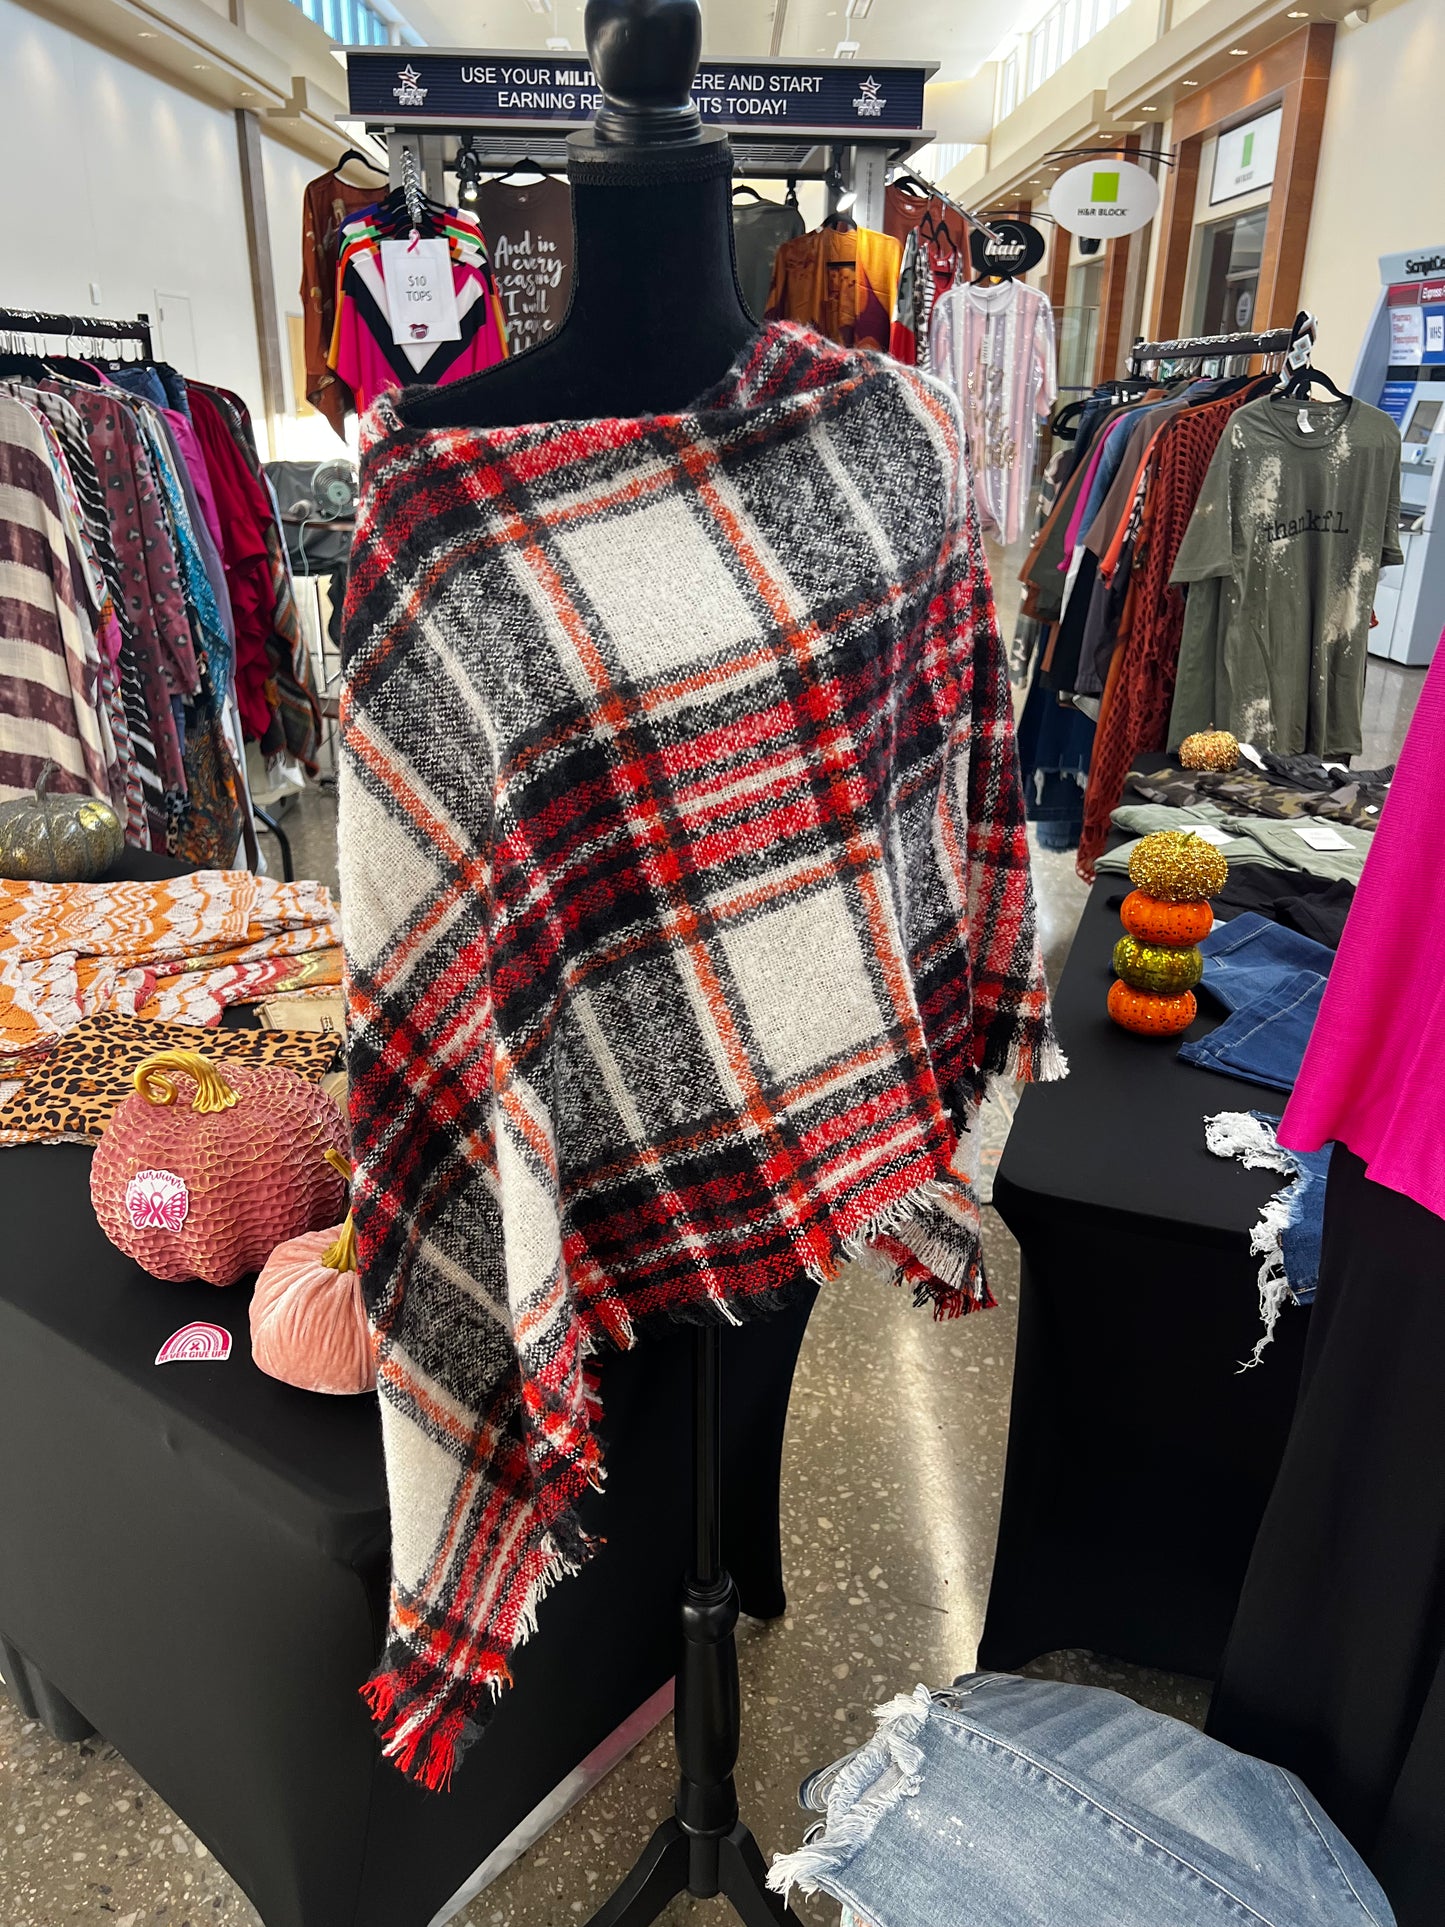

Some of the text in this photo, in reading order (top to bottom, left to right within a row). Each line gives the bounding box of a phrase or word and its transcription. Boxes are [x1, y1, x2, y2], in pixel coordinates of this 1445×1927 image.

[461, 67, 597, 87] USE YOUR MILIT
[690, 73, 823, 93] ERE AND START
[498, 91, 575, 110] EARNING
[689, 97, 787, 115] NTS TODAY!
[1077, 208, 1127, 216] H&R BLOCK
[494, 230, 557, 270] And in
[985, 239, 1026, 256] hair
[512, 256, 567, 288] every
[1405, 255, 1445, 276] ScriptCe
[408, 275, 427, 288] $10
[405, 290, 433, 302] TOPS
[503, 289, 521, 317] I
[137, 1170, 183, 1189] survivor
[158, 1350, 228, 1362] NEVER GIVE UP!
